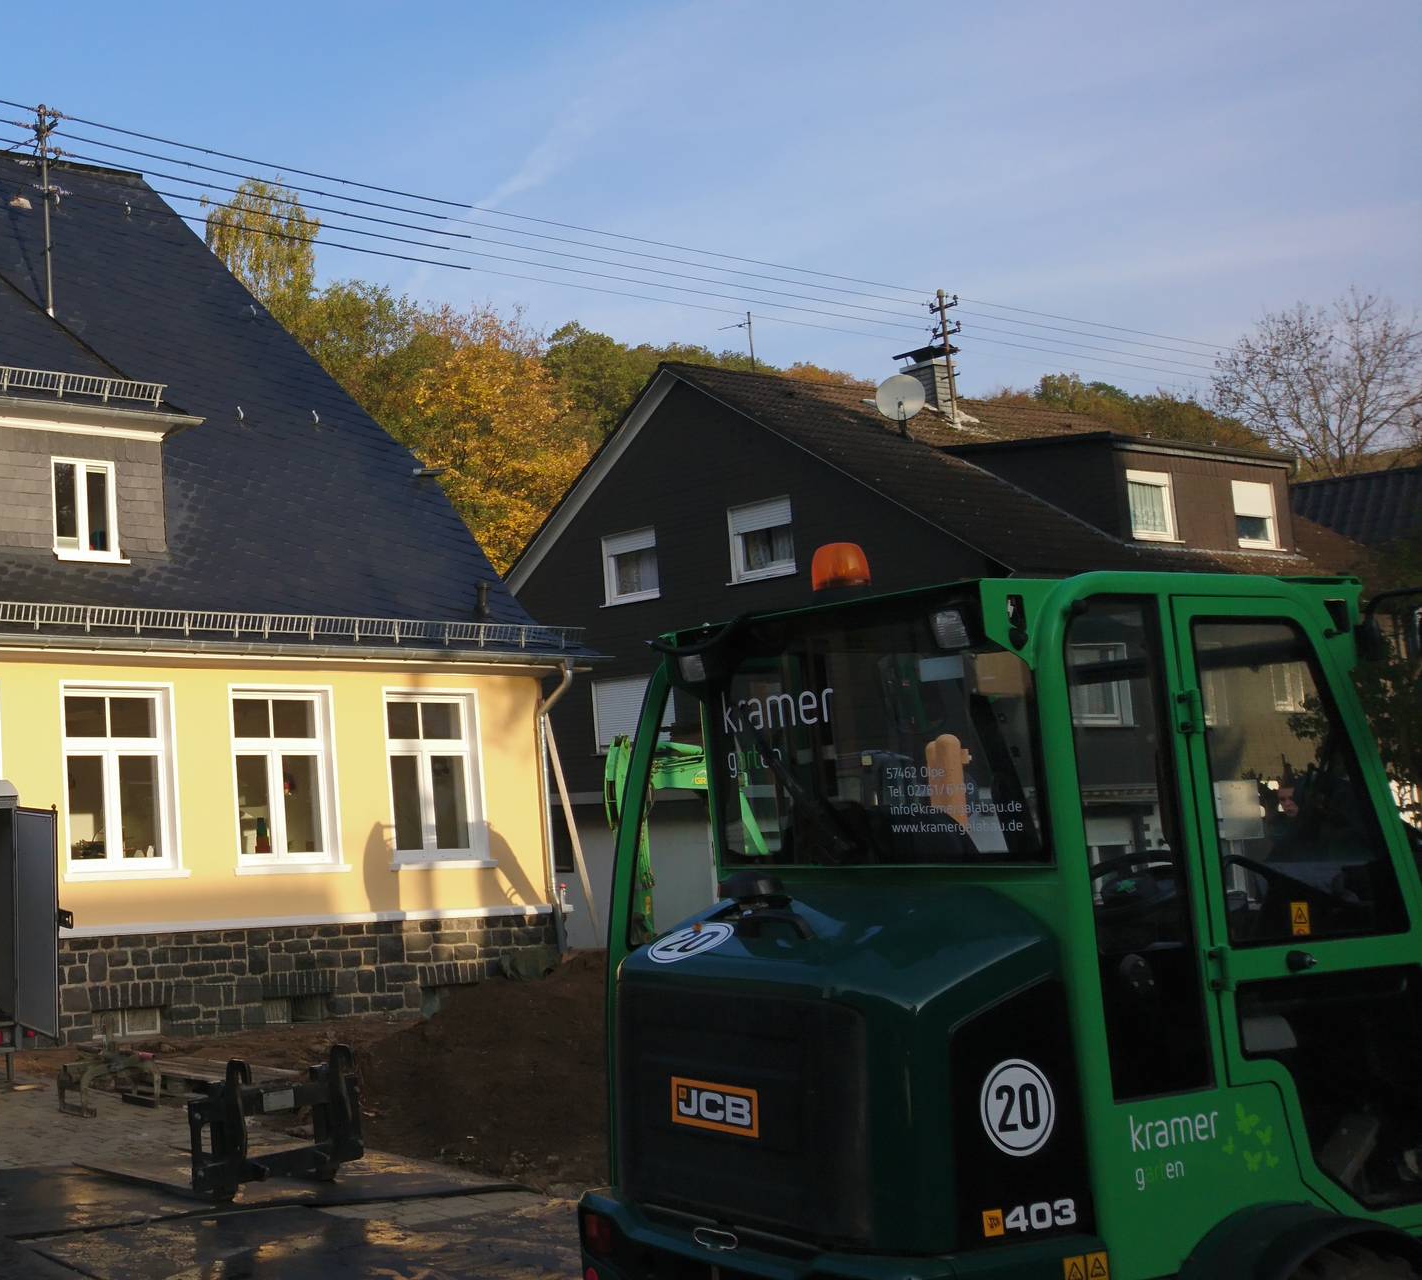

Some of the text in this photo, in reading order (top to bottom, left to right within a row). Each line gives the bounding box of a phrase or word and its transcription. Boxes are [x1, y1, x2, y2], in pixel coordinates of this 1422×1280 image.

[721, 688, 833, 734] kramer
[886, 766, 917, 779] 57462
[887, 785, 904, 797] Tel.
[657, 931, 721, 953] 20
[678, 1089, 751, 1126] JCB
[995, 1083, 1041, 1132] 20
[1129, 1111, 1218, 1152] kramer
[1005, 1199, 1077, 1232] 403
